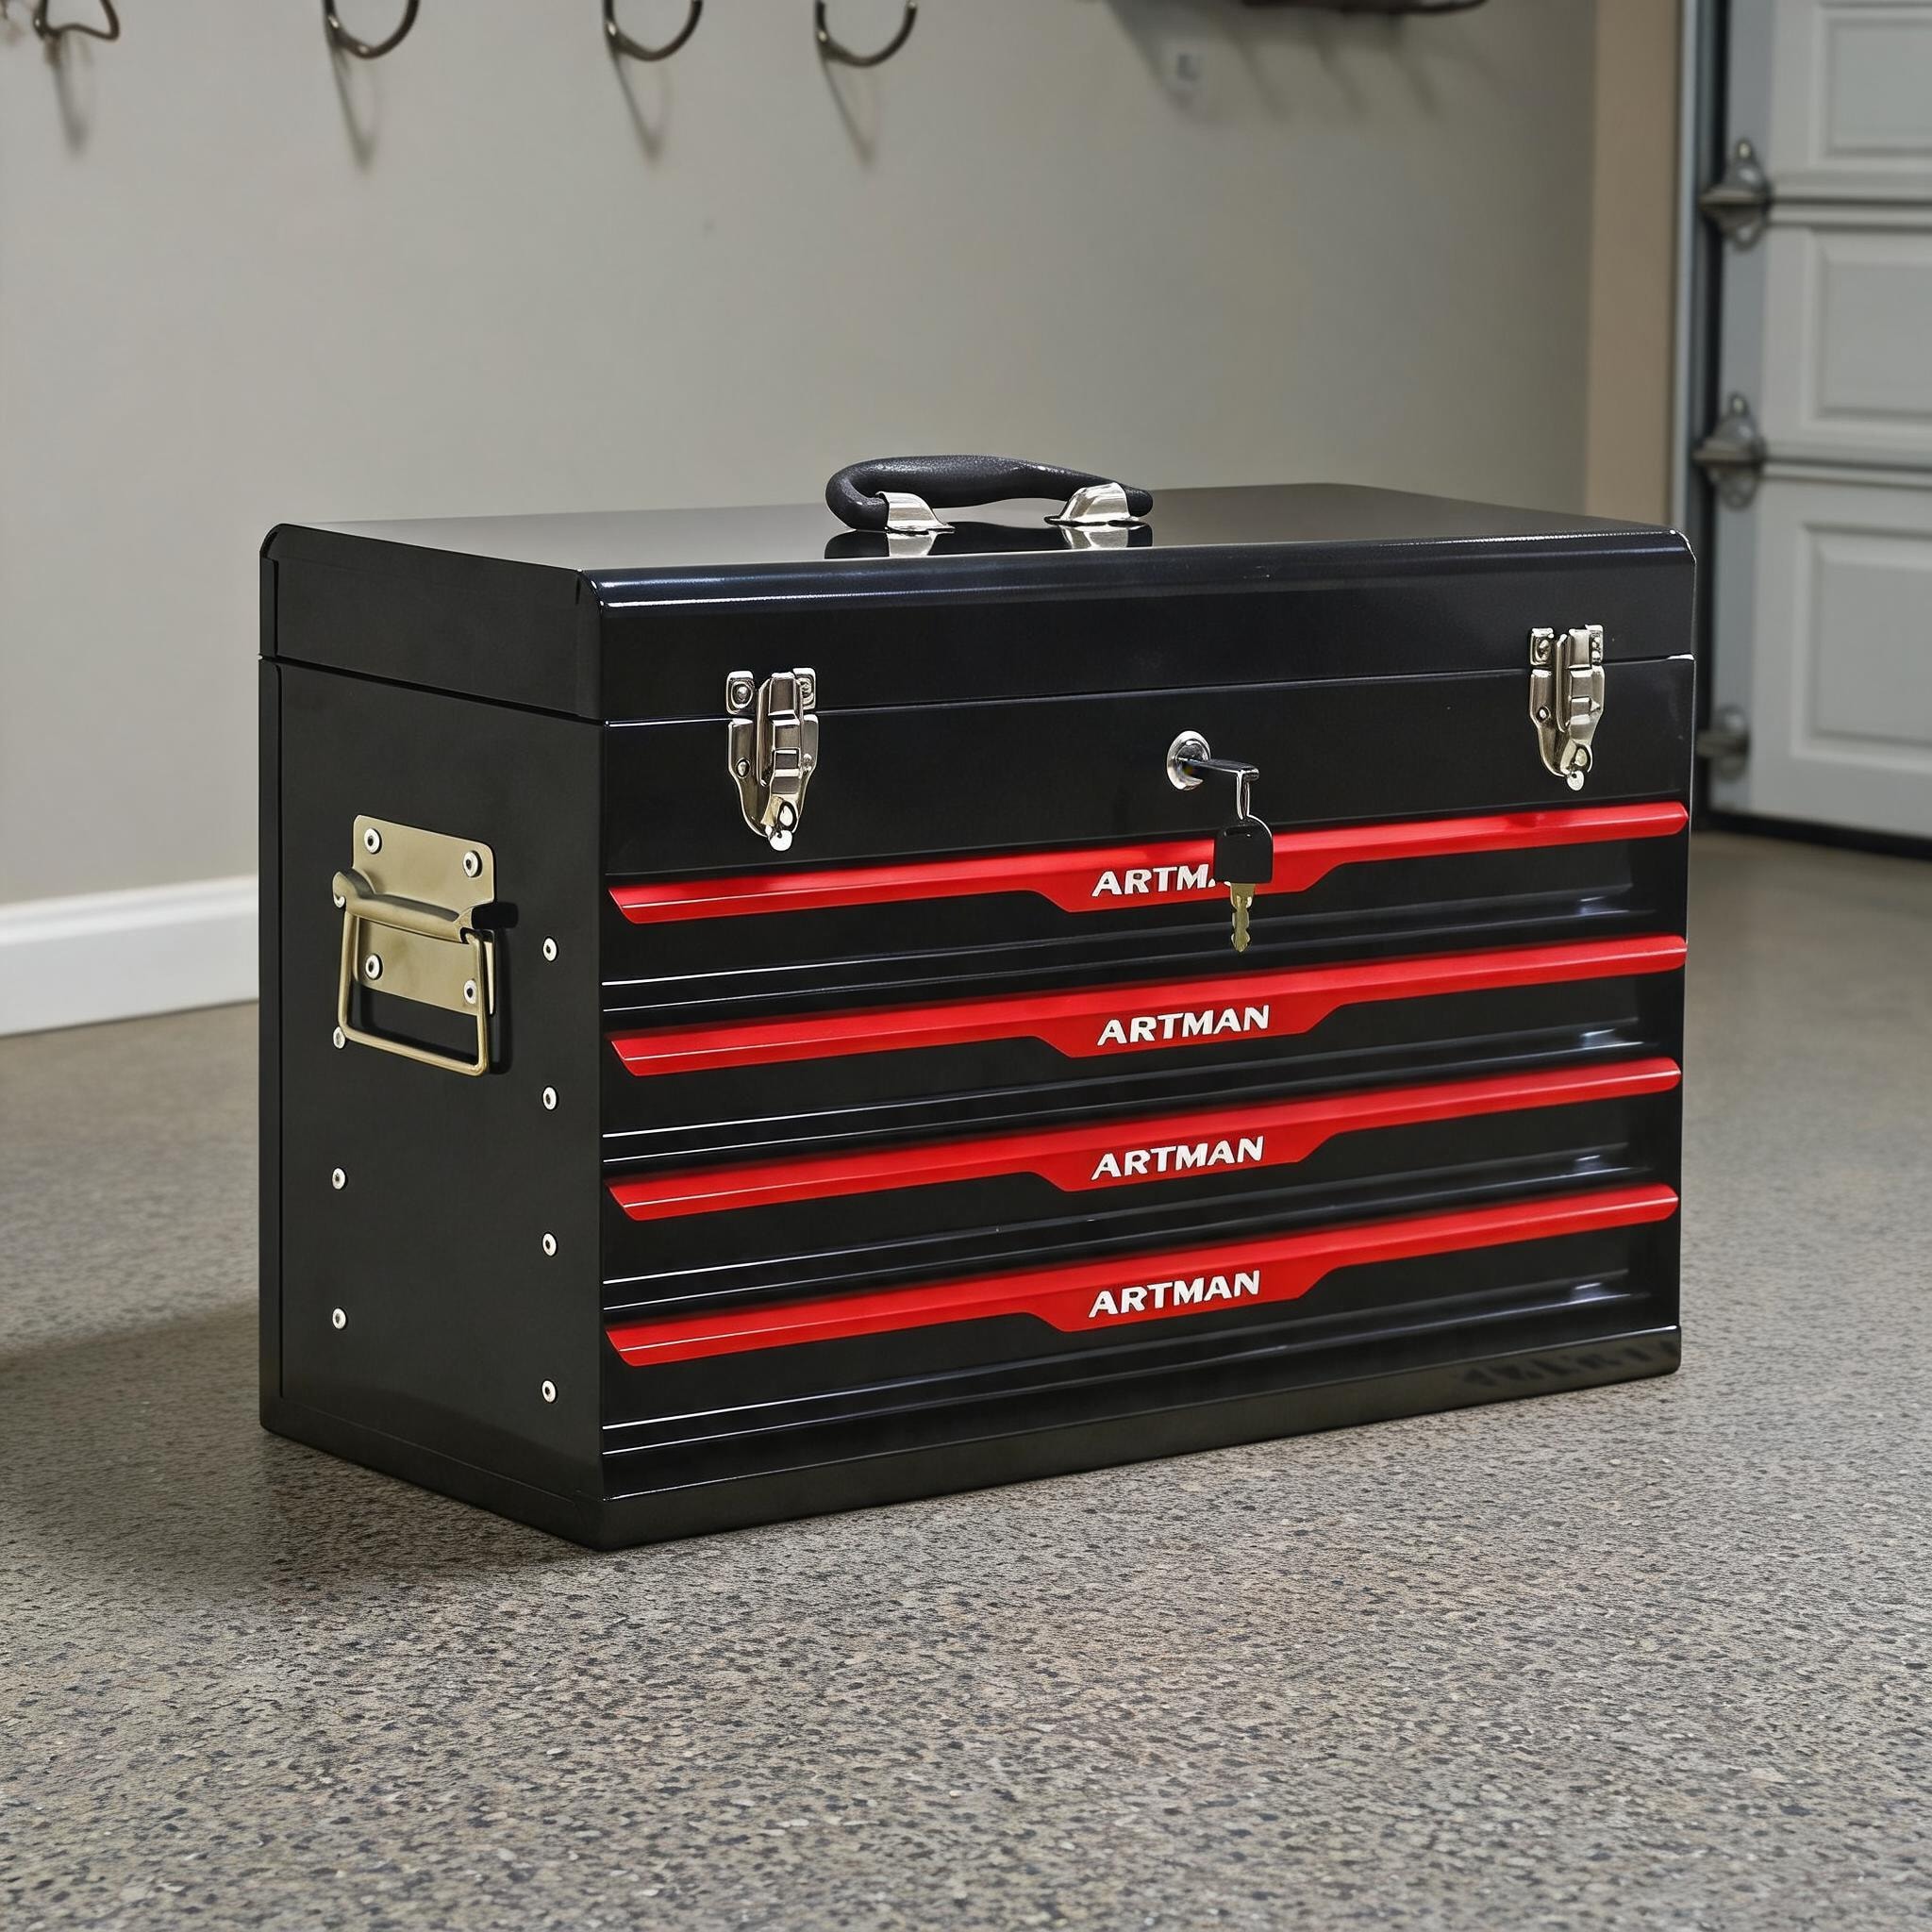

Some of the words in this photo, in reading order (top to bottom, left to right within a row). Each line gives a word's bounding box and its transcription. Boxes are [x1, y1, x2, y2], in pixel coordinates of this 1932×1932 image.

[1091, 863, 1231, 897] ARTM
[1096, 1004, 1270, 1046] ARTMAN
[1091, 1135, 1264, 1181] ARTMAN
[1088, 1270, 1260, 1318] ARTMAN
